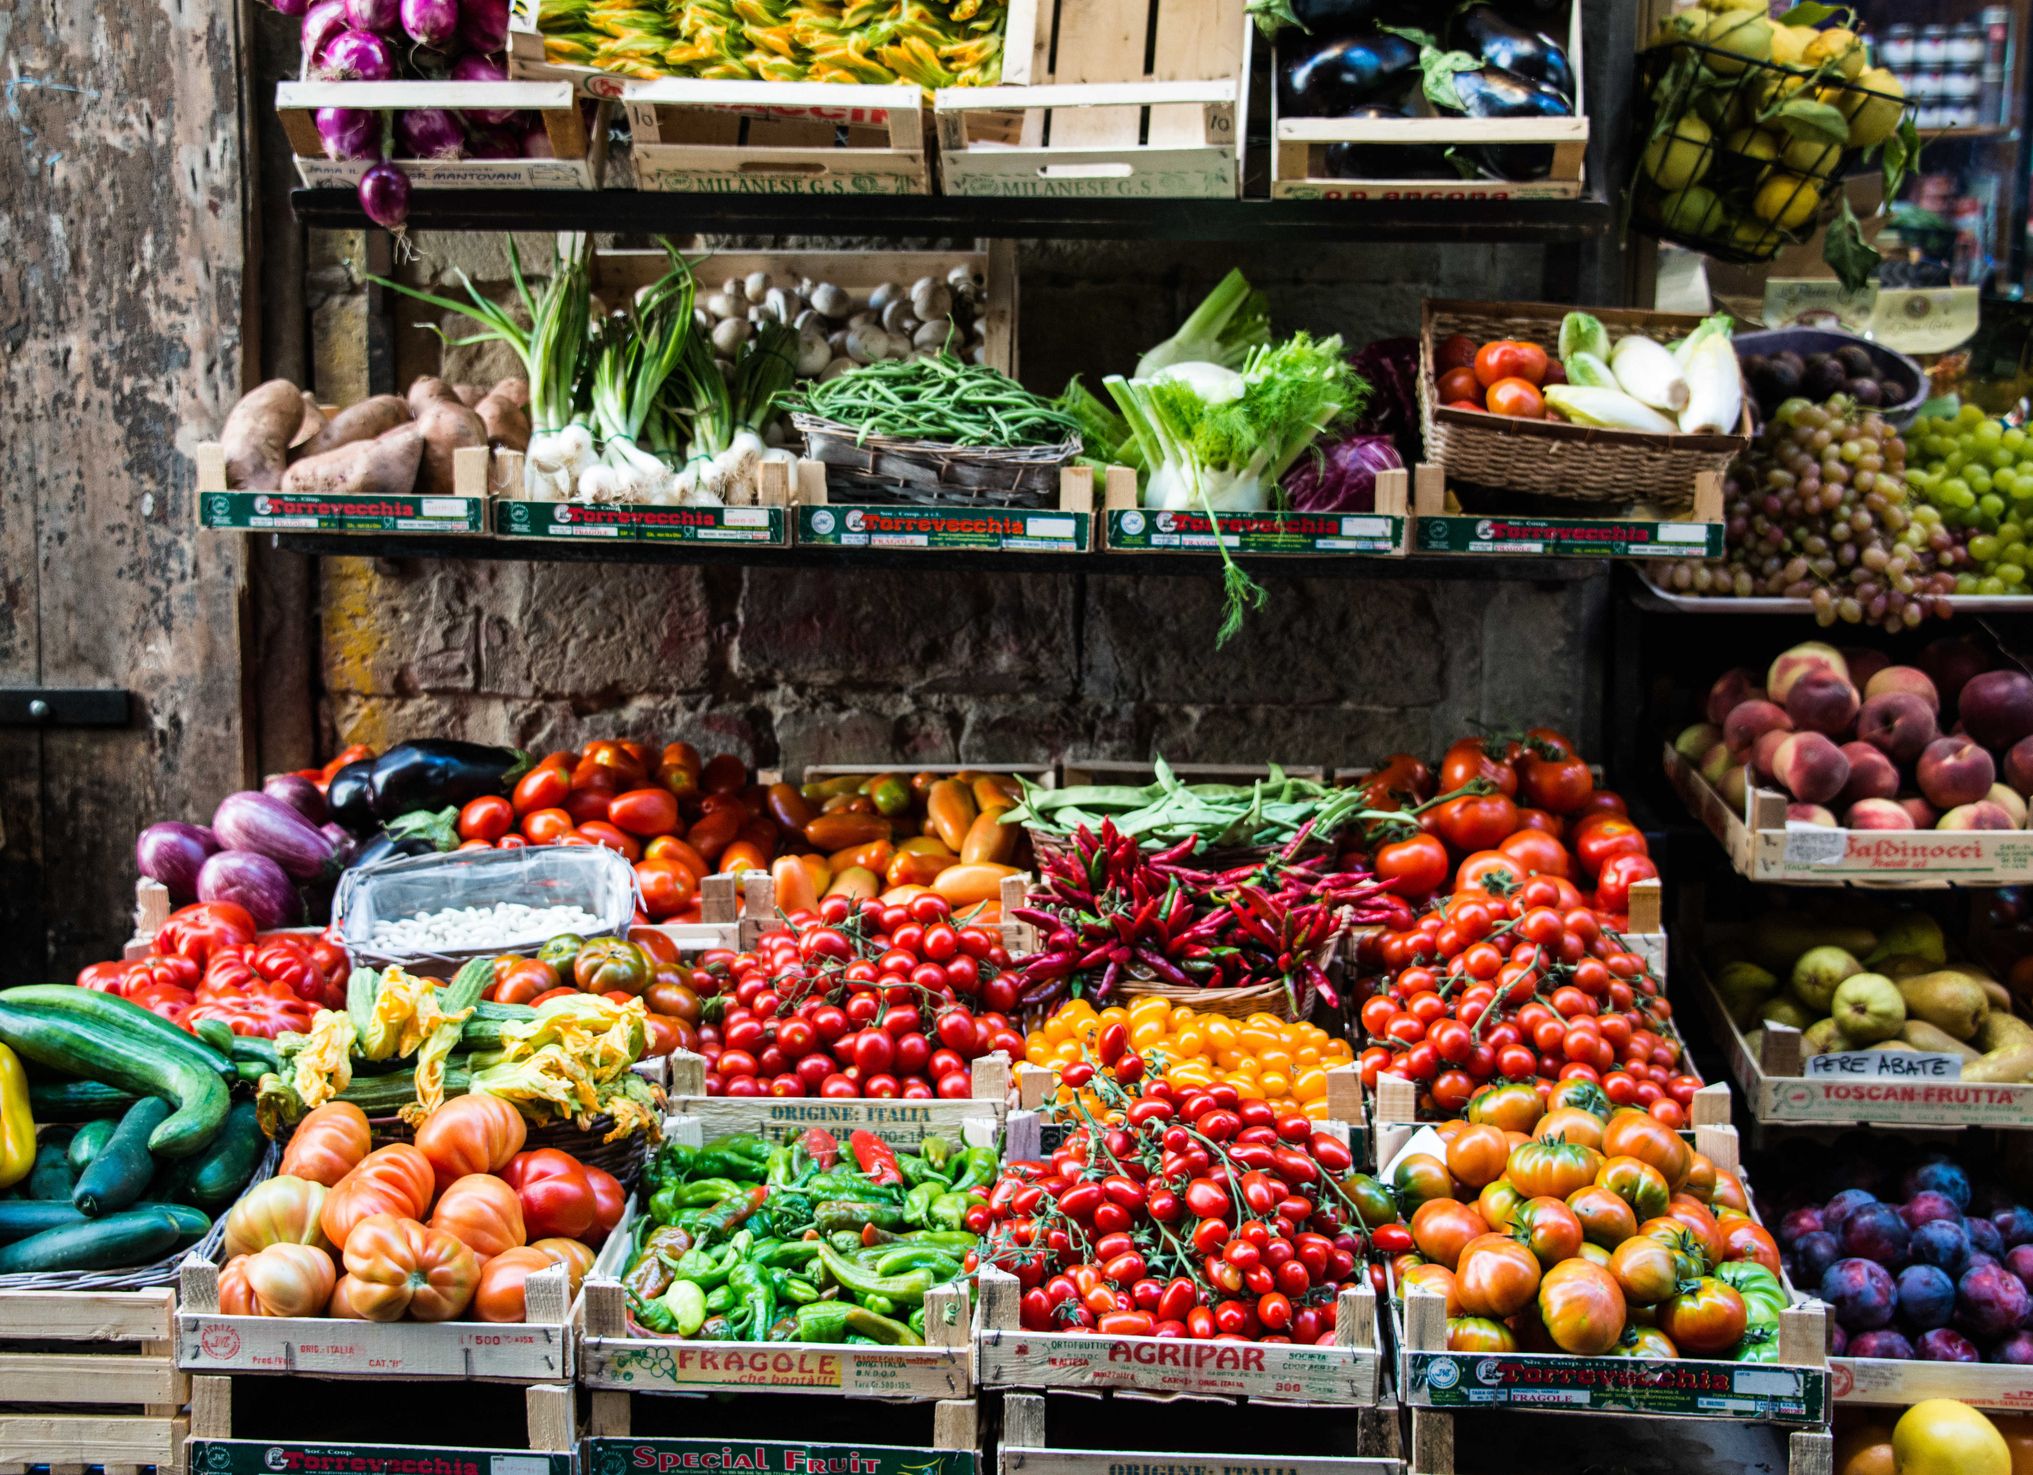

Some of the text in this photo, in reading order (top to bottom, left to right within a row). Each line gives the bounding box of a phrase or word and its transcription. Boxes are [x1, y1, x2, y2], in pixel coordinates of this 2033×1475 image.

[433, 171, 522, 182] MANTOVANI
[697, 177, 806, 194] MILANESE
[1000, 180, 1113, 197] MILANESE
[267, 498, 414, 516] Torrevecchia
[567, 507, 715, 526] Torrevecchia
[861, 513, 1024, 535] Torrevecchia
[1490, 522, 1649, 542] Torrevecchia
[1812, 1055, 1951, 1076] PERE ABATE
[1823, 1084, 2014, 1105] TOSCAN-FRUTTA
[770, 1106, 931, 1122] ORIGINE: ITALIA
[475, 1335, 500, 1346] 500
[678, 1349, 836, 1375] FRAGOLE
[1108, 1340, 1265, 1372] AGRIPAR
[1497, 1362, 1730, 1392] Torrevecchia
[1511, 1393, 1573, 1403] FRAGOLE
[327, 1448, 355, 1457] Coop.
[283, 1451, 478, 1475] Torrevecchia
